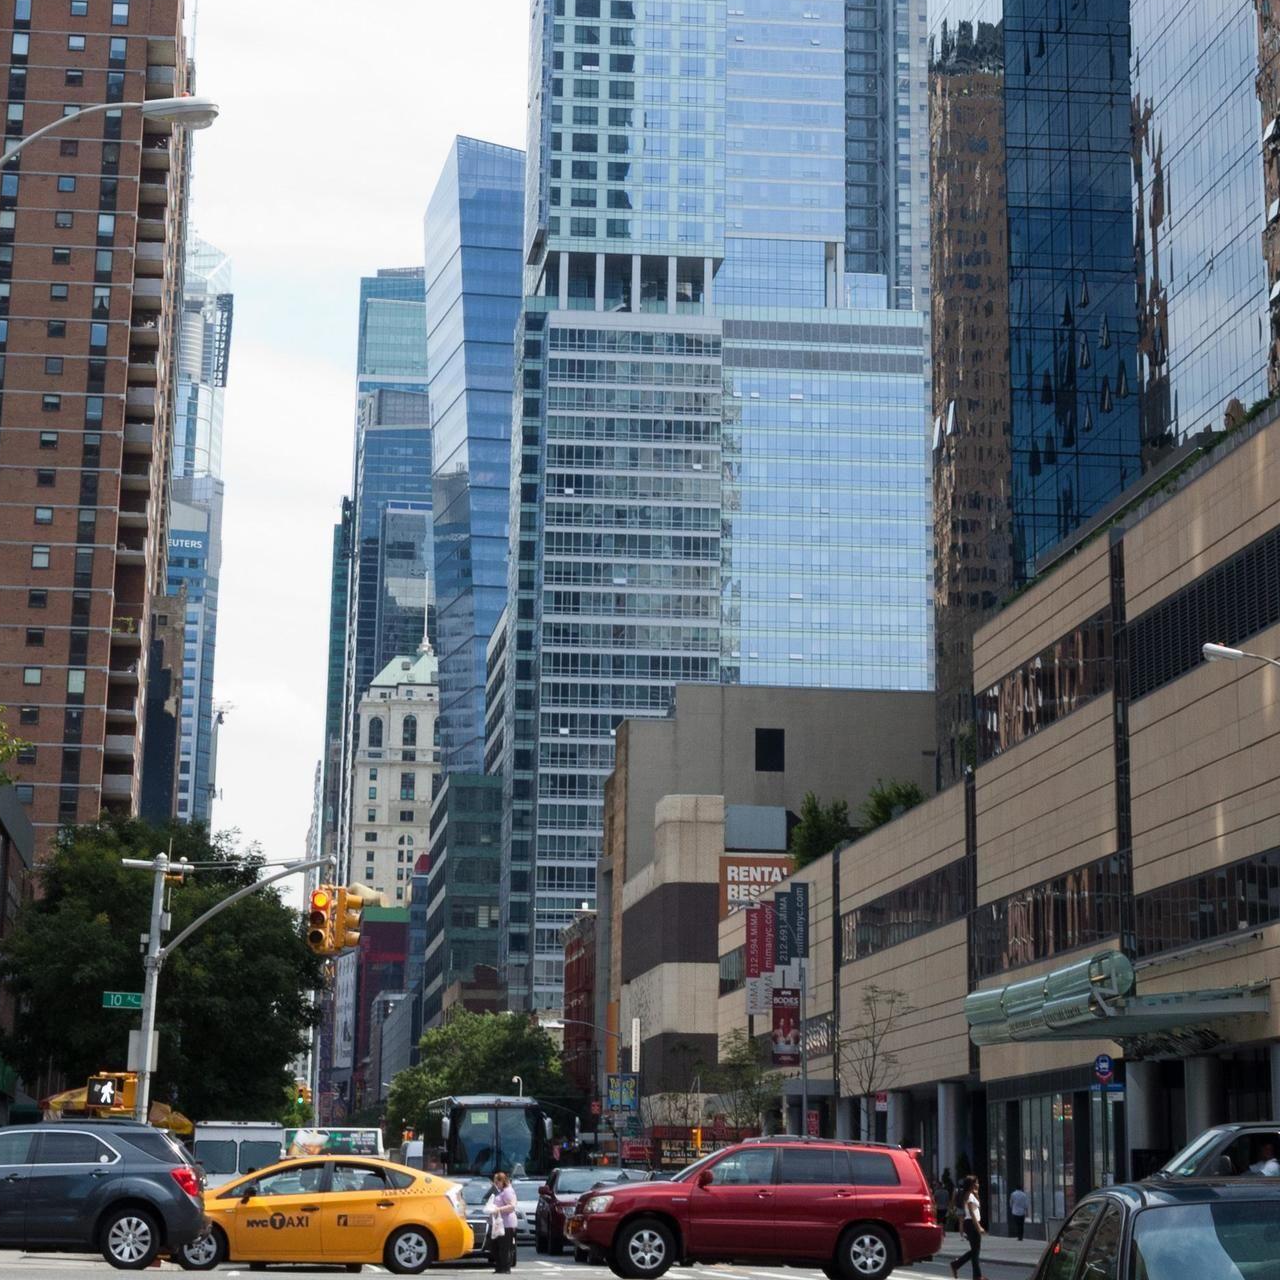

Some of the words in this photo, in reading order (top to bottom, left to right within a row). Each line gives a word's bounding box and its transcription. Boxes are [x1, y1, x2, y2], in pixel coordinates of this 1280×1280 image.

[168, 538, 203, 549] EUTERS
[111, 994, 122, 1006] 10
[246, 1219, 269, 1228] NYC
[270, 1212, 309, 1230] TAXI
